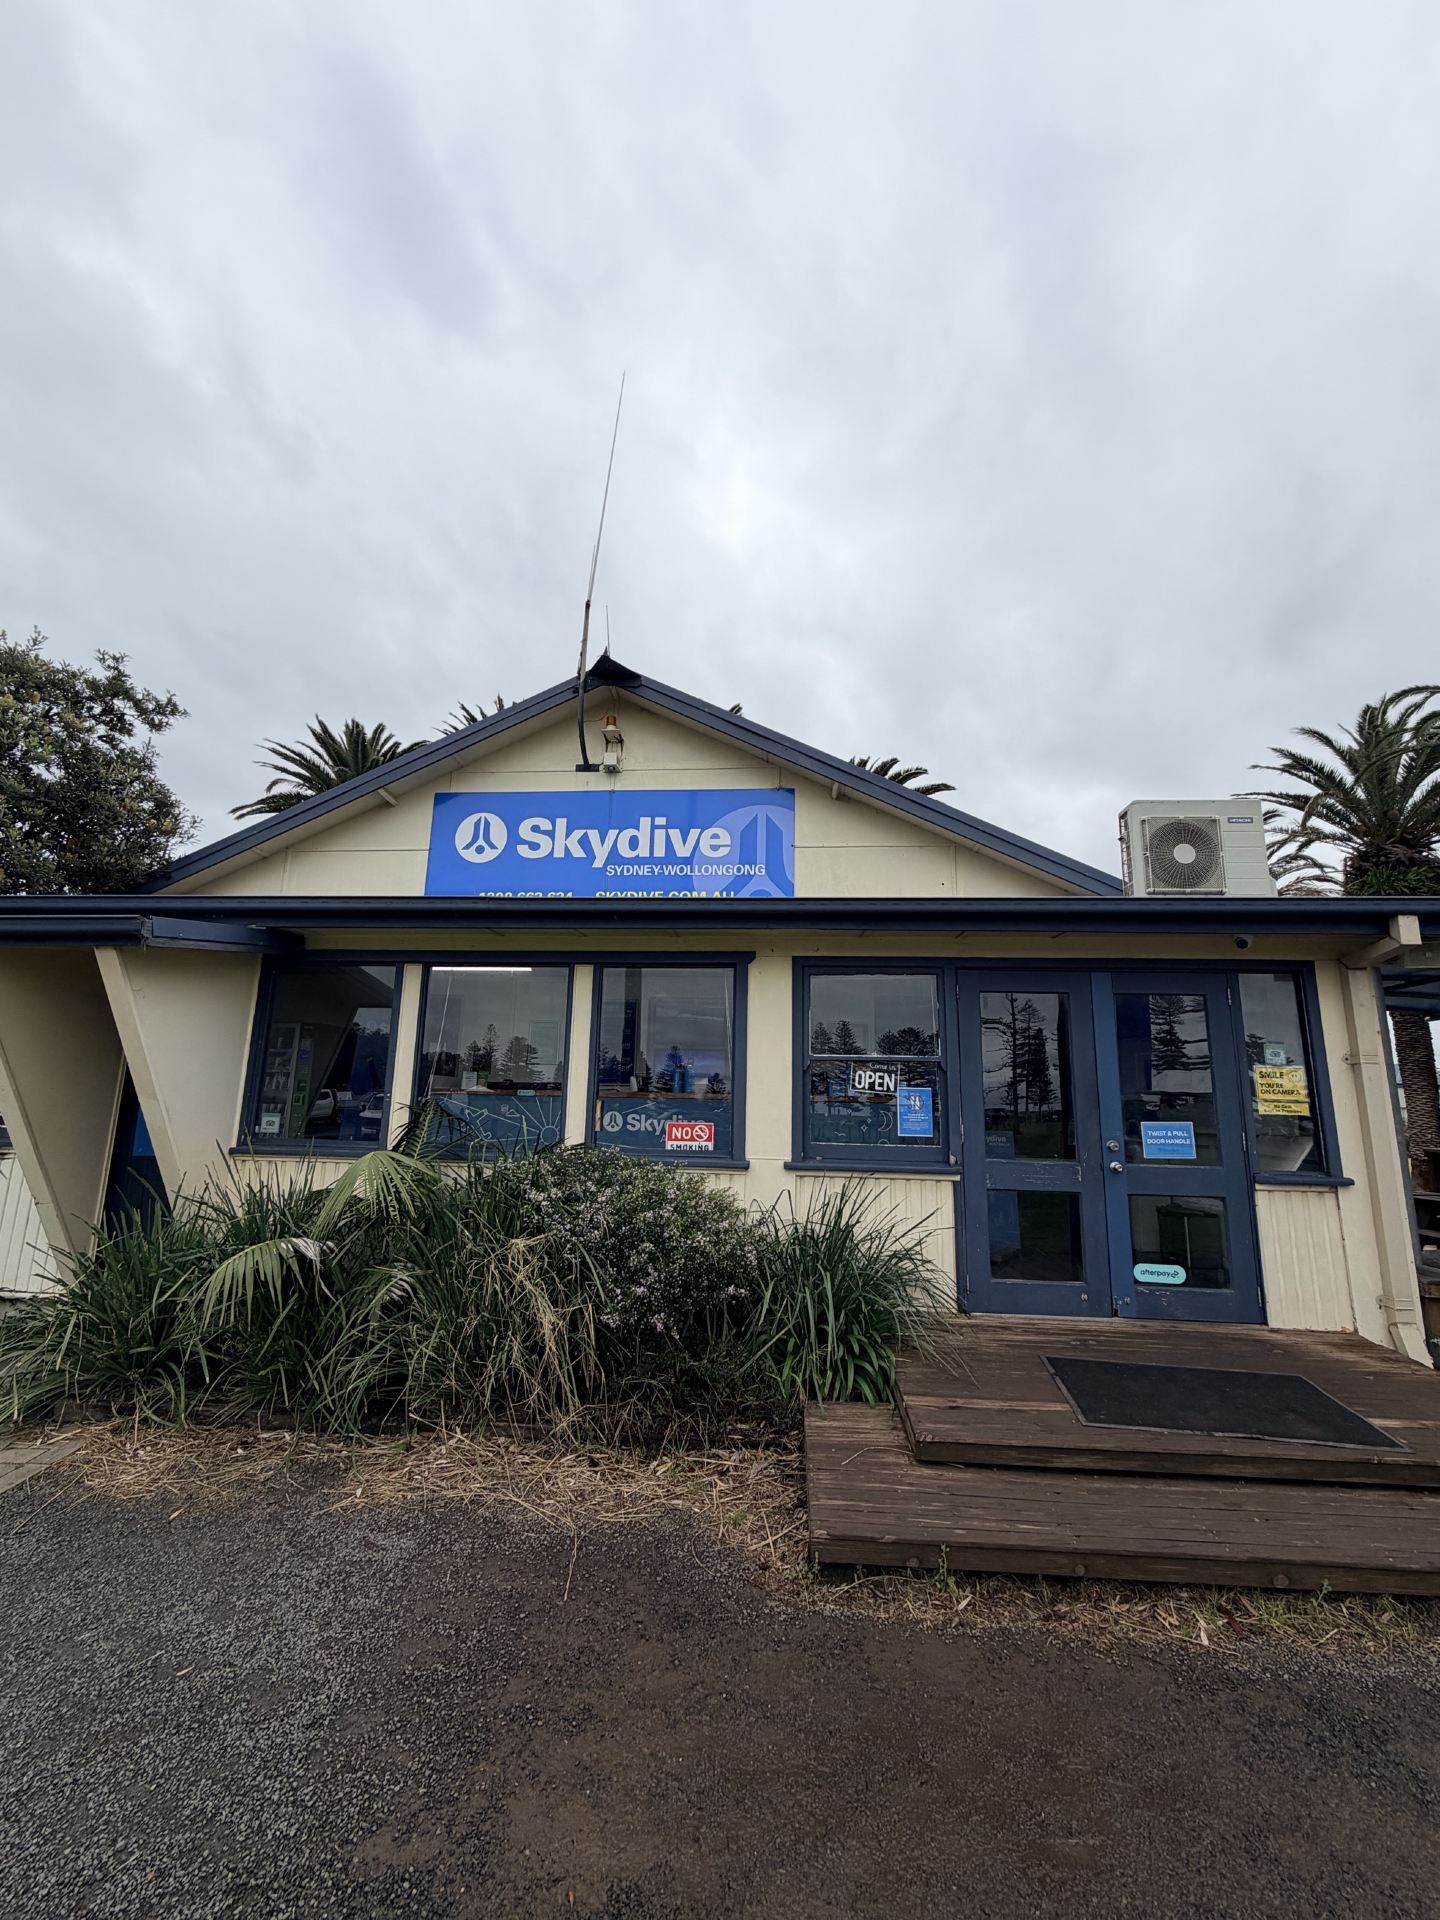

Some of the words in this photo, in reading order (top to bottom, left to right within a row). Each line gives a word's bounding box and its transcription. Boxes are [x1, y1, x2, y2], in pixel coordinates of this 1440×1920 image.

[516, 816, 732, 868] Skydive
[606, 864, 766, 876] SYDNEY-WOLLONGONG
[1258, 1070, 1284, 1079] SMILE
[854, 1070, 895, 1091] OPEN
[1271, 1088, 1301, 1096] CAMERA
[671, 1126, 692, 1139] NO
[670, 1143, 709, 1151] SMOKING
[1140, 1269, 1171, 1278] afterpay
